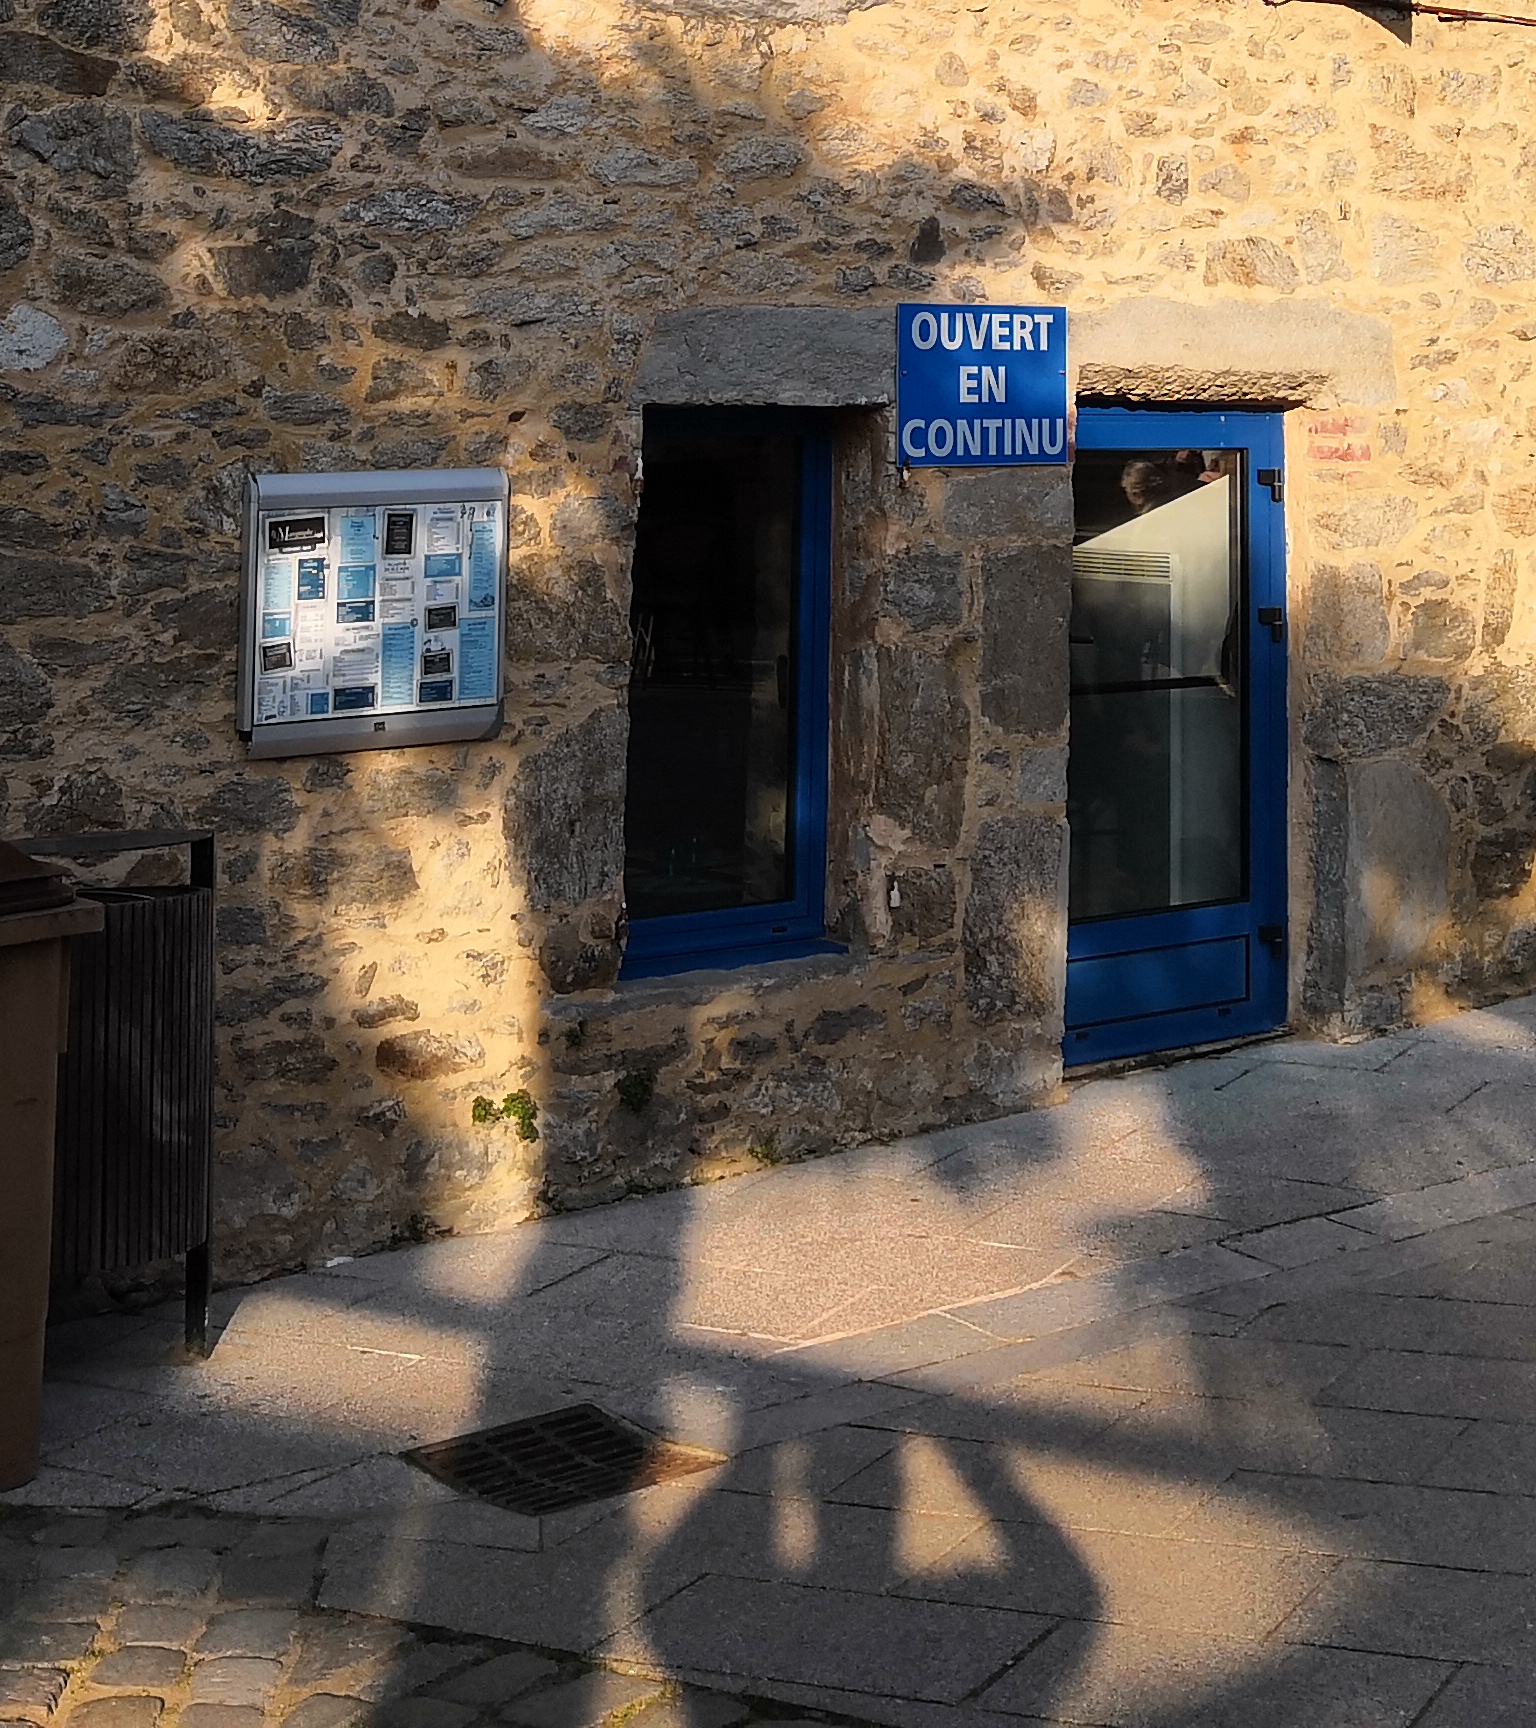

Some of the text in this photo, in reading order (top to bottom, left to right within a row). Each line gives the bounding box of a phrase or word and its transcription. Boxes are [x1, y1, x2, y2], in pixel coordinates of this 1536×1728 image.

[910, 311, 1054, 352] OUVERT
[958, 366, 1007, 404] EN
[901, 417, 1065, 458] CONTINU
